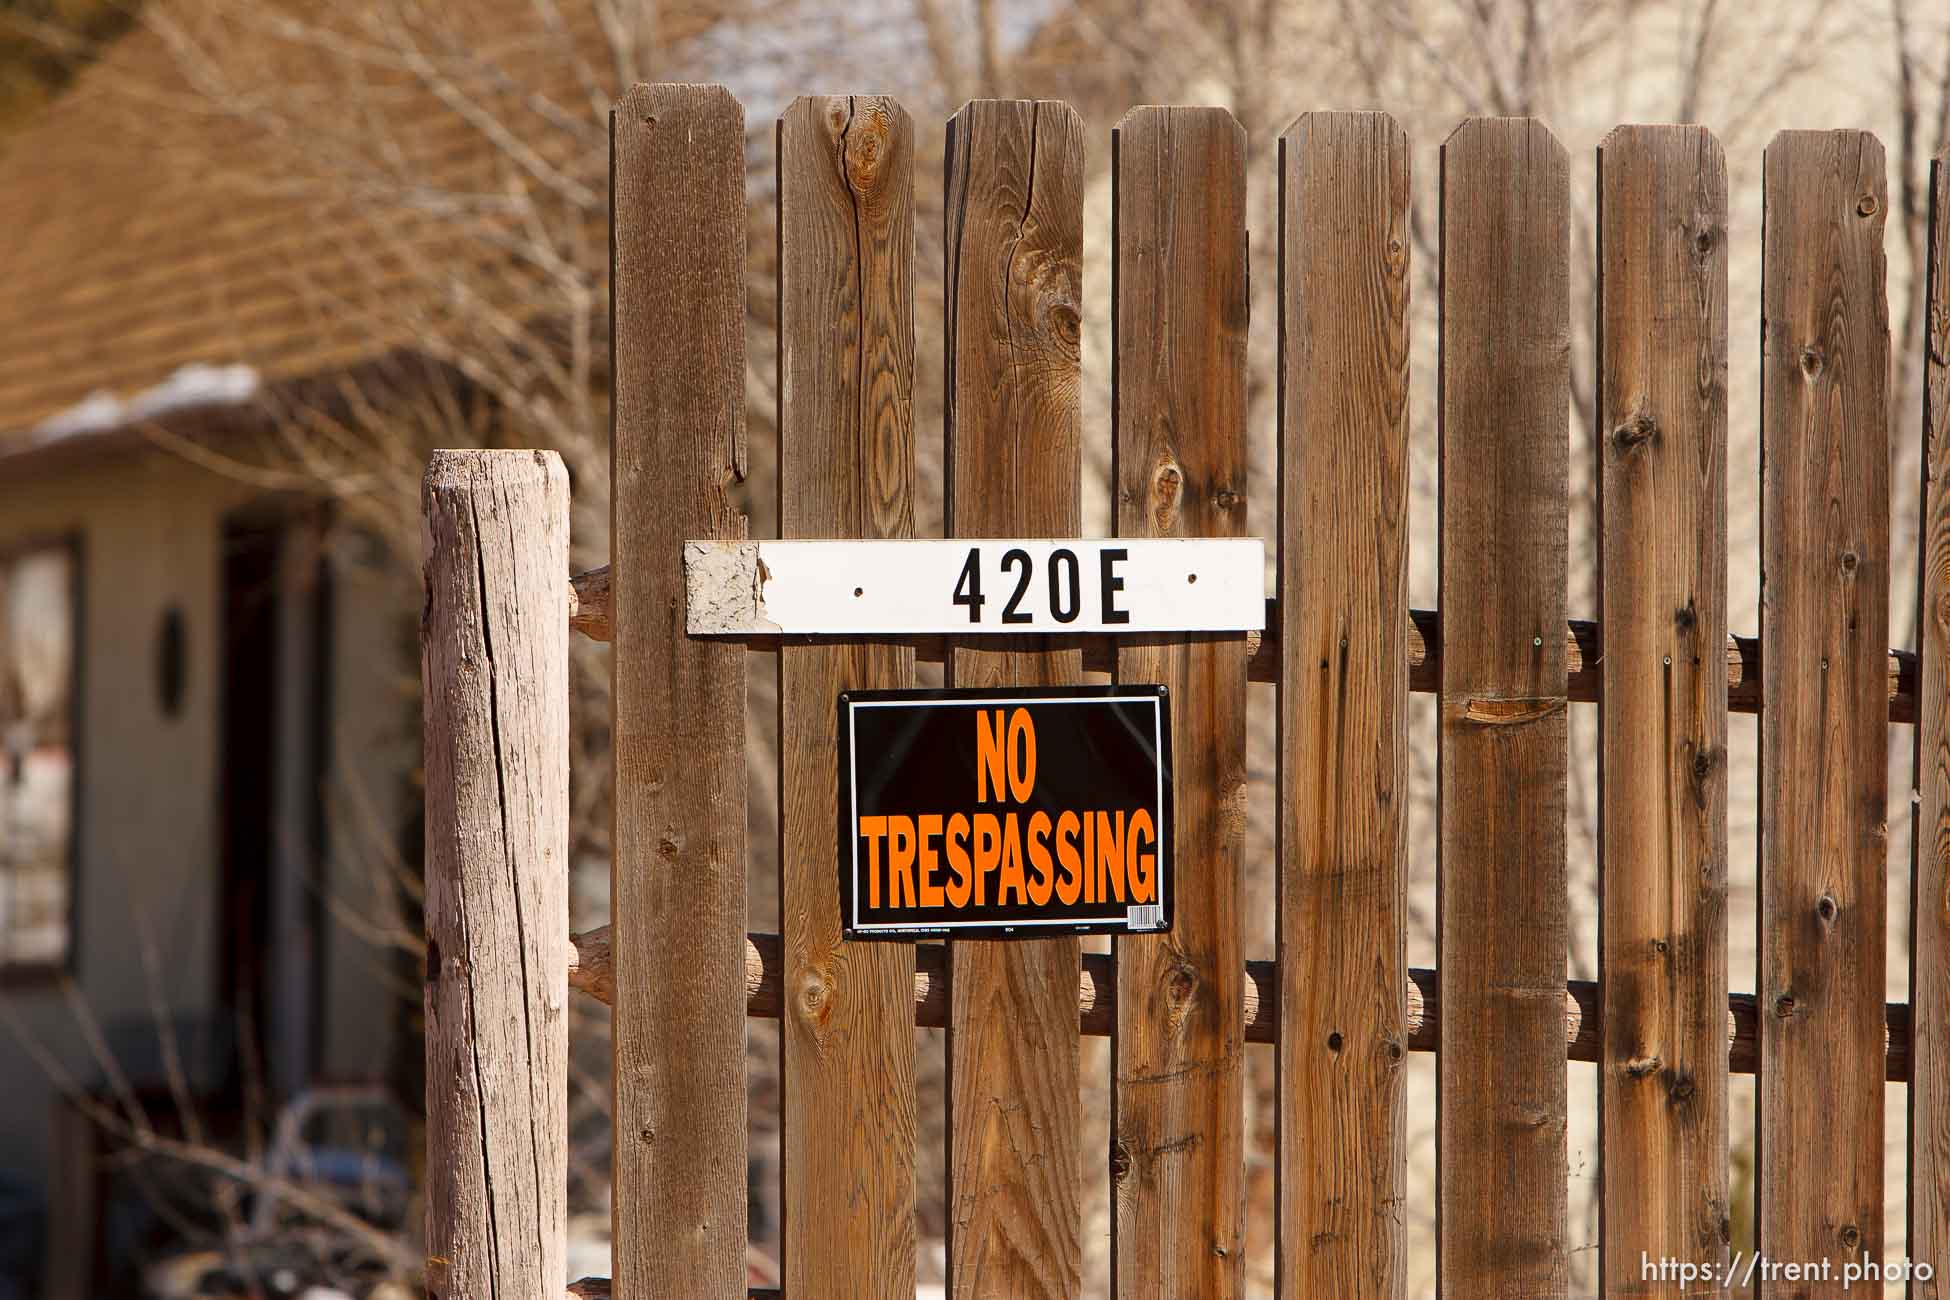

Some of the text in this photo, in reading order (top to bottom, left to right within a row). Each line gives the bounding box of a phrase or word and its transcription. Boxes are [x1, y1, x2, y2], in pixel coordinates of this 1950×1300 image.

[953, 547, 1130, 625] 420E
[976, 707, 1037, 804] NO
[859, 808, 1156, 909] TRESPASSING
